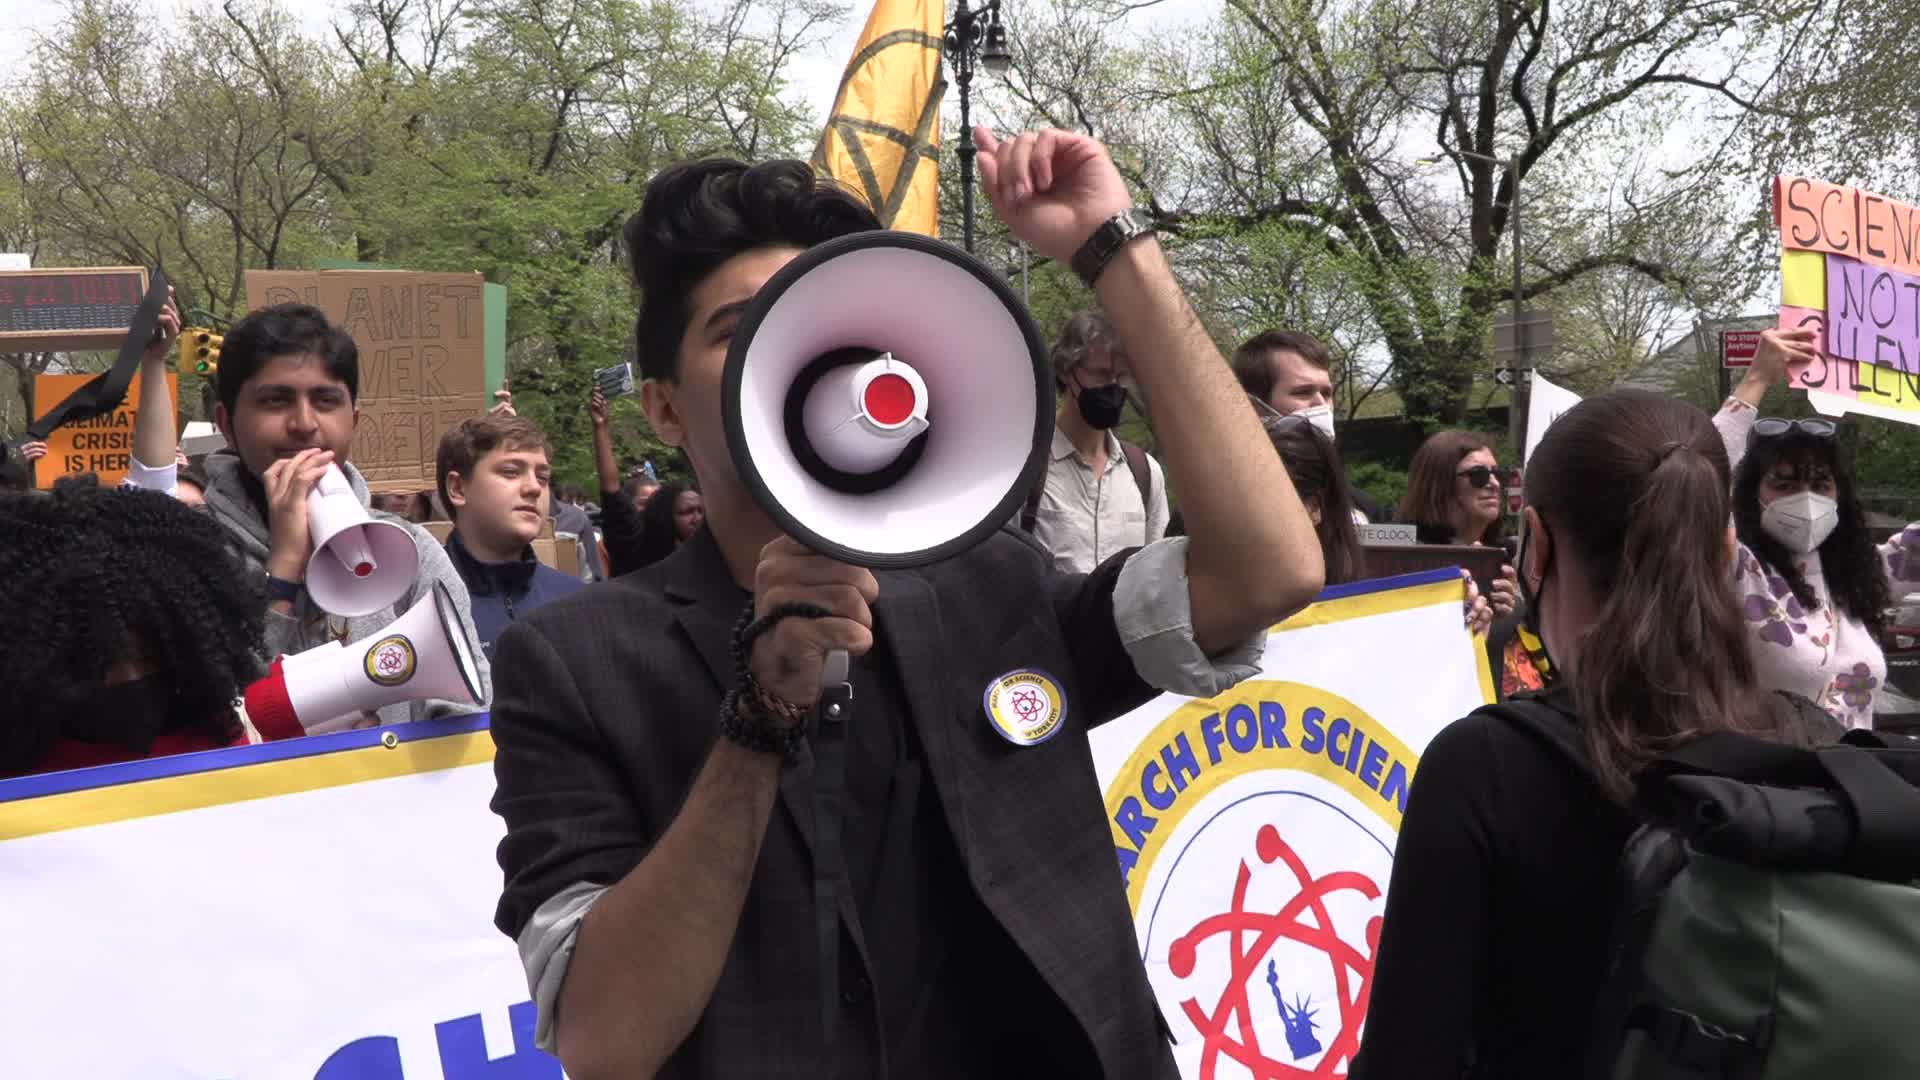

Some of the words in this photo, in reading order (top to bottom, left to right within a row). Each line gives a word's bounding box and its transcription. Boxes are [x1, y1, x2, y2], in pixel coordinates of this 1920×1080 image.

[1788, 178, 1920, 265] SCIEN
[1841, 265, 1920, 339] NOT
[64, 455, 84, 472] IS
[72, 432, 136, 450] CRISI
[1200, 700, 1291, 767] FOR
